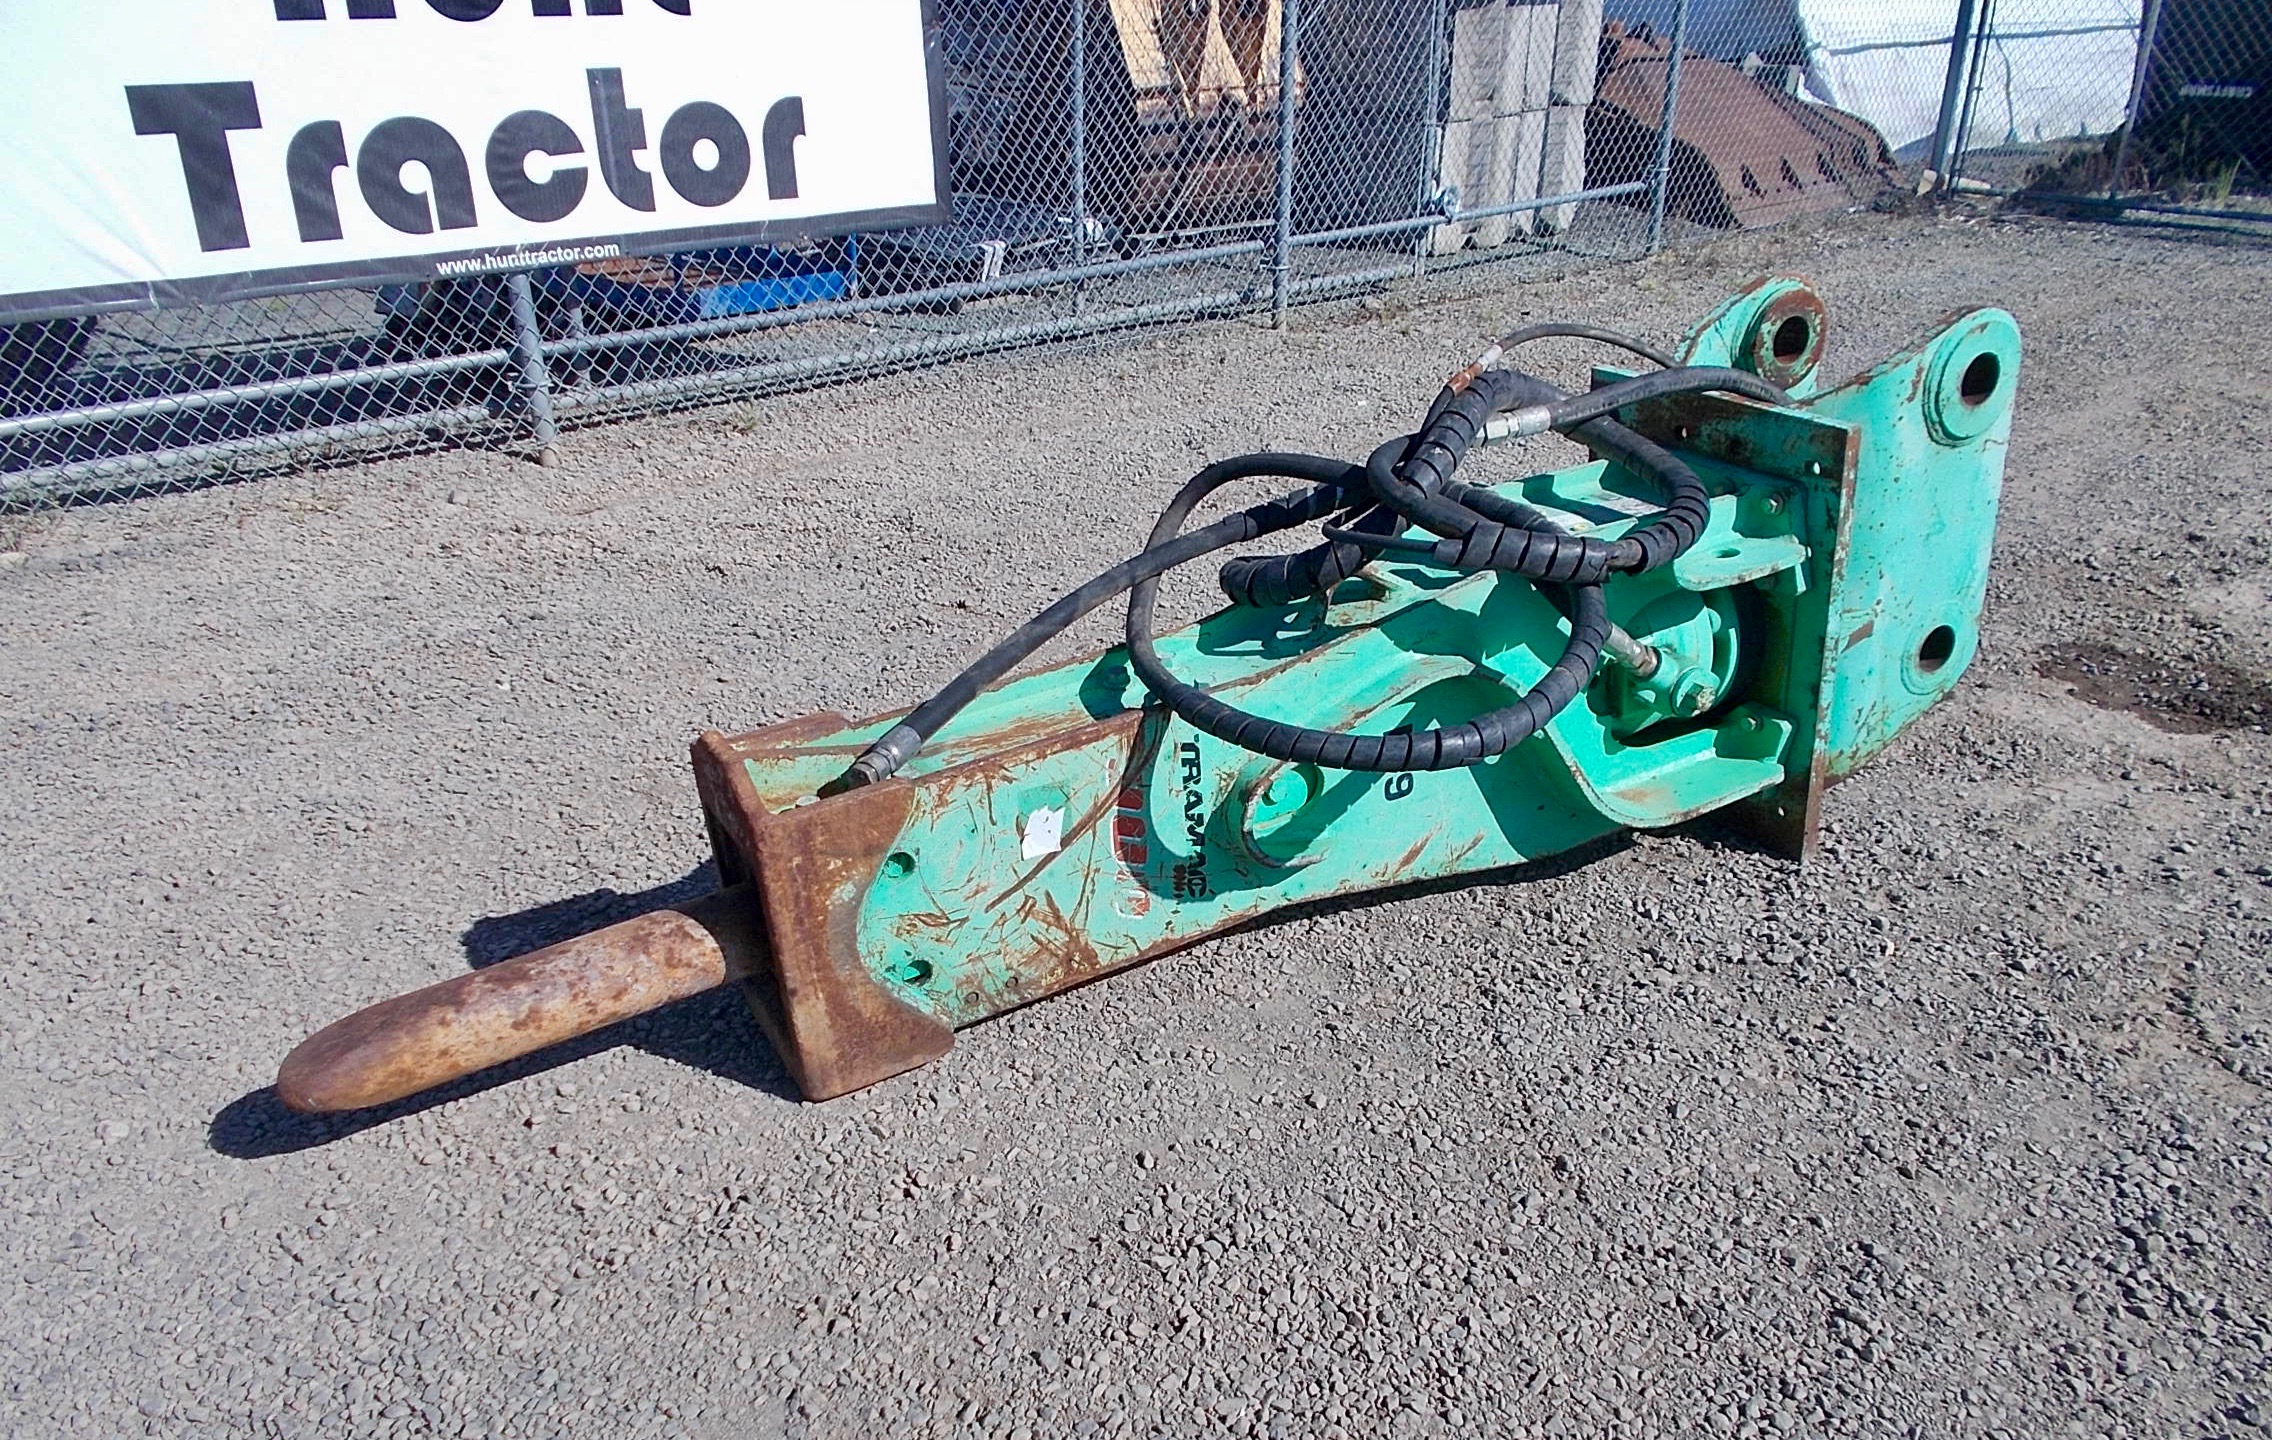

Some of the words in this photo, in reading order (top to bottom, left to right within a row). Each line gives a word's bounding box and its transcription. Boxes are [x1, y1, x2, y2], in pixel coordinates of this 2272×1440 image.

[125, 68, 806, 252] Tractor
[436, 243, 620, 275] www.hunttractor.com
[1180, 733, 1208, 899] TRAMAC
